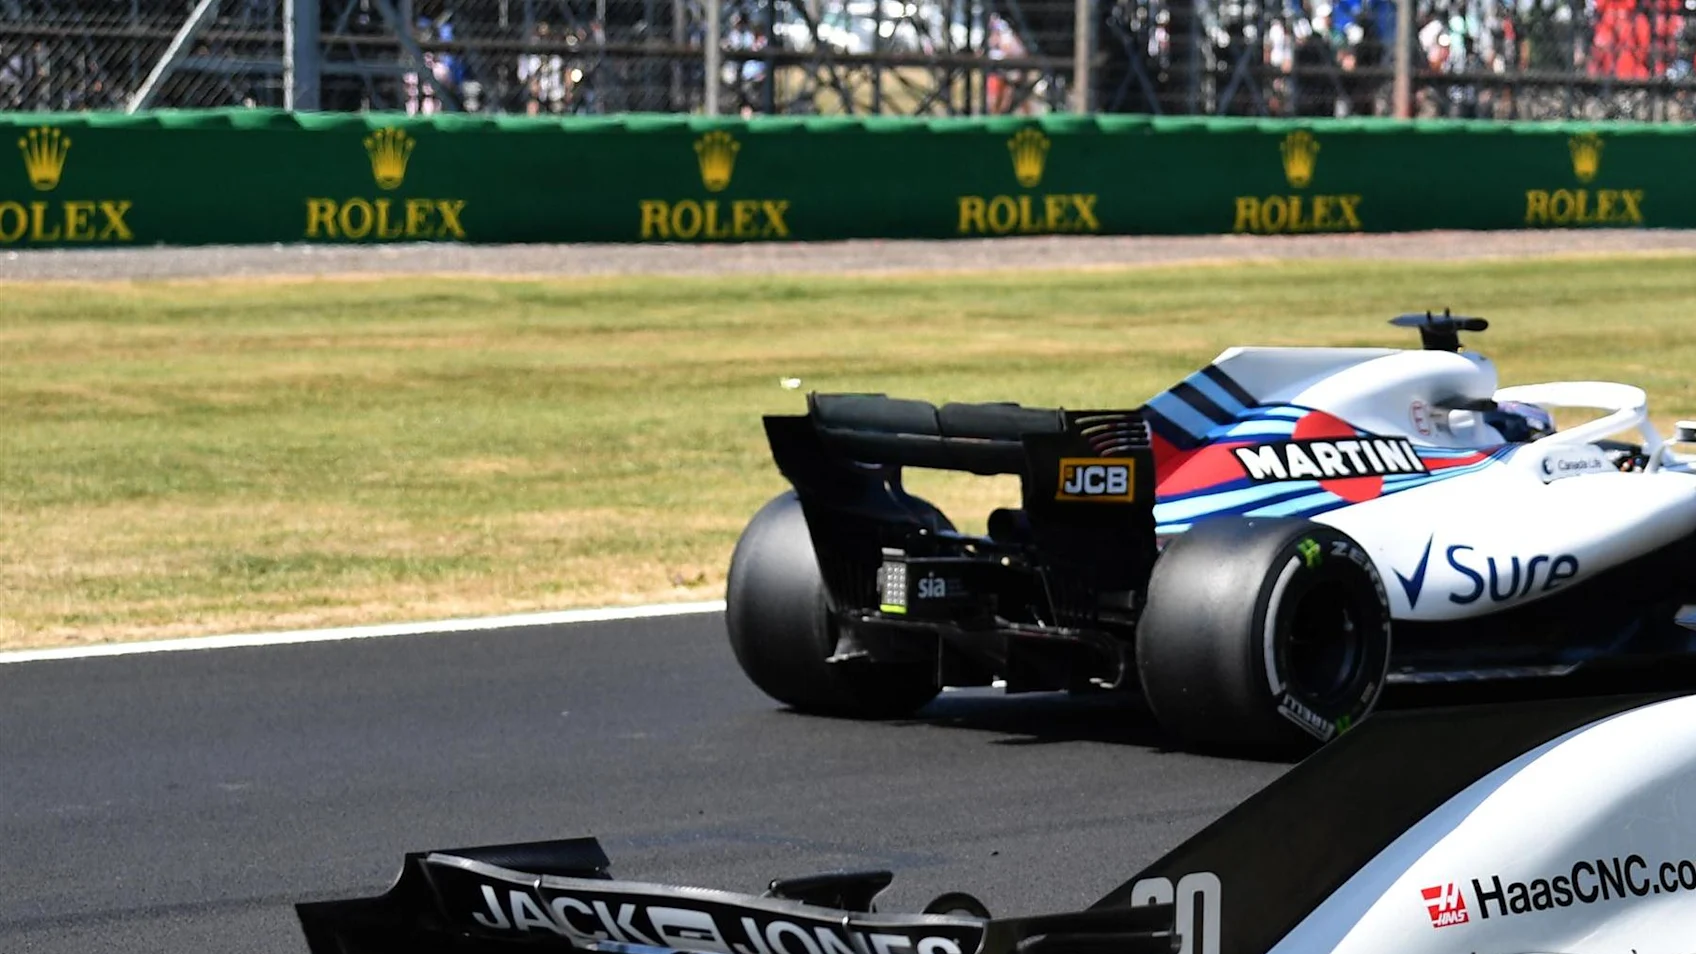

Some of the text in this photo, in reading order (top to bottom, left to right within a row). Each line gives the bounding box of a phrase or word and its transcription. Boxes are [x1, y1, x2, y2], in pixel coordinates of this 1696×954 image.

[0, 201, 132, 240] OLEX
[306, 198, 464, 237] ROLEX
[640, 200, 788, 237] ROLEX
[958, 195, 1099, 231] ROLEX
[1234, 195, 1360, 230] ROLEX
[1526, 190, 1642, 222] ROLEX
[1235, 440, 1425, 480] MARTINI
[1064, 465, 1128, 494] JCB
[917, 571, 946, 599] sia
[1446, 544, 1580, 605] Sure
[472, 884, 659, 947] JACK
